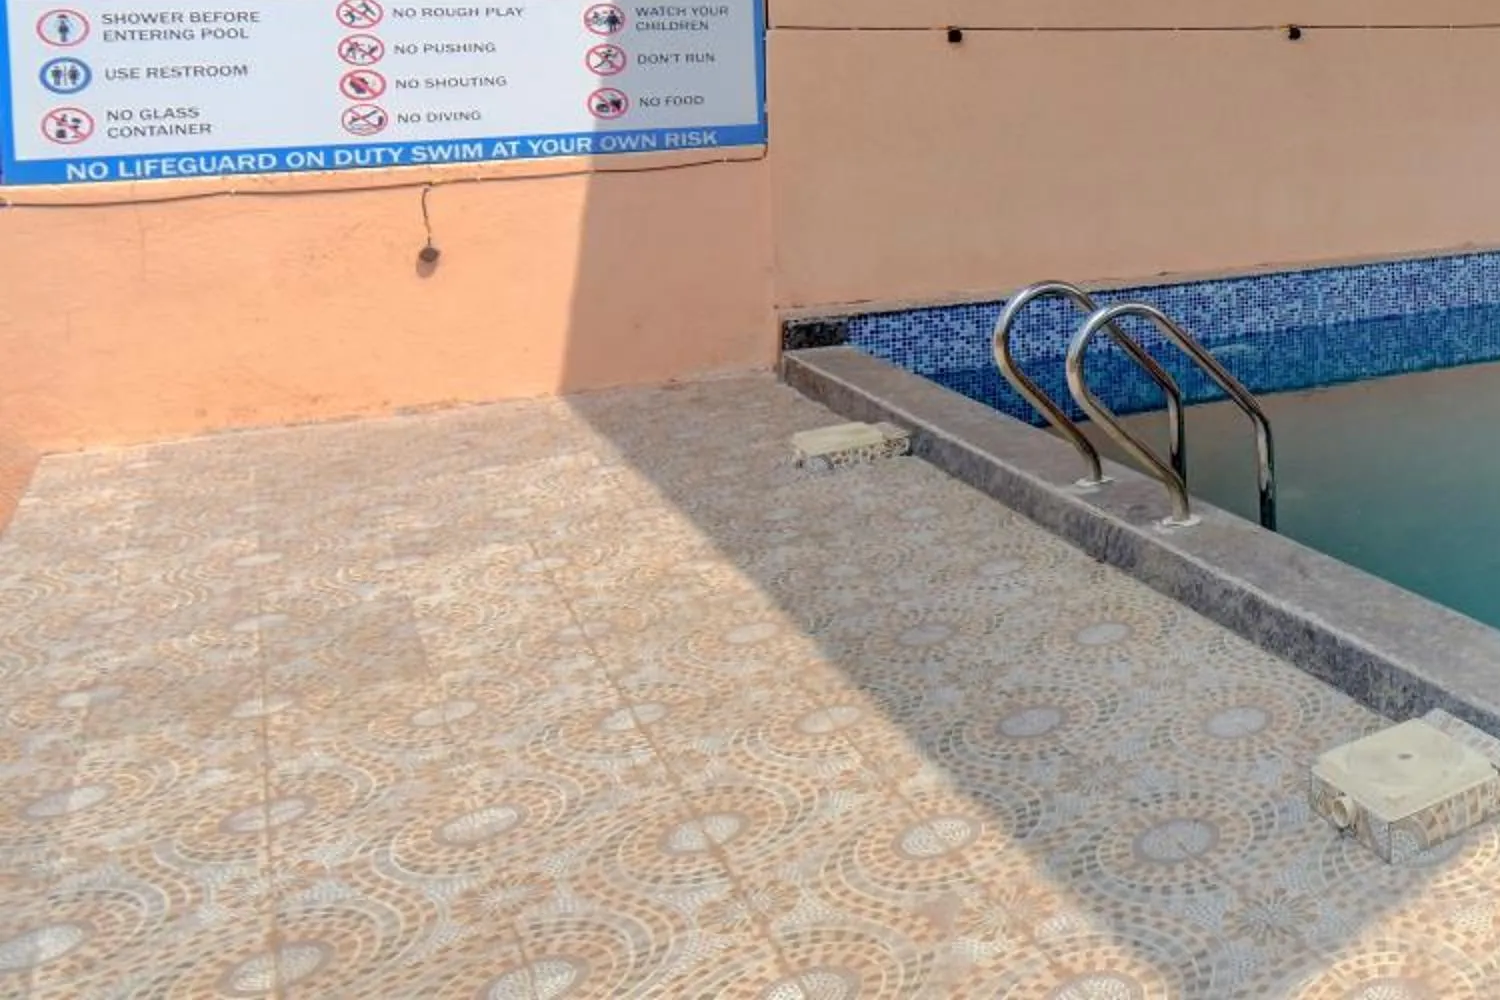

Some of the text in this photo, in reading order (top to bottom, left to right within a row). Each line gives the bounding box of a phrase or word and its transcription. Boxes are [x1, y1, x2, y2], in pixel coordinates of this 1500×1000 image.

[102, 11, 261, 25] SHOWER BEFORE
[392, 6, 524, 19] NO ROUGH PLAY
[635, 5, 728, 18] WATCH YOUR
[636, 19, 709, 32] CHILDREN
[102, 27, 249, 42] ENTERING POOL
[394, 41, 496, 54] NO PUSHING
[637, 52, 715, 65] DON'T RUN
[104, 64, 249, 80] USE RESTROOM
[396, 75, 508, 89] NO SHOUTING
[639, 95, 705, 108] NO FOOD
[106, 106, 200, 122] NO GLASS
[397, 110, 482, 124] NO DIVING
[107, 122, 212, 138] CONTAINER
[66, 131, 718, 181] NO LIFEGUARD ON DUTY SWIM AT YOUR OWN RISK
